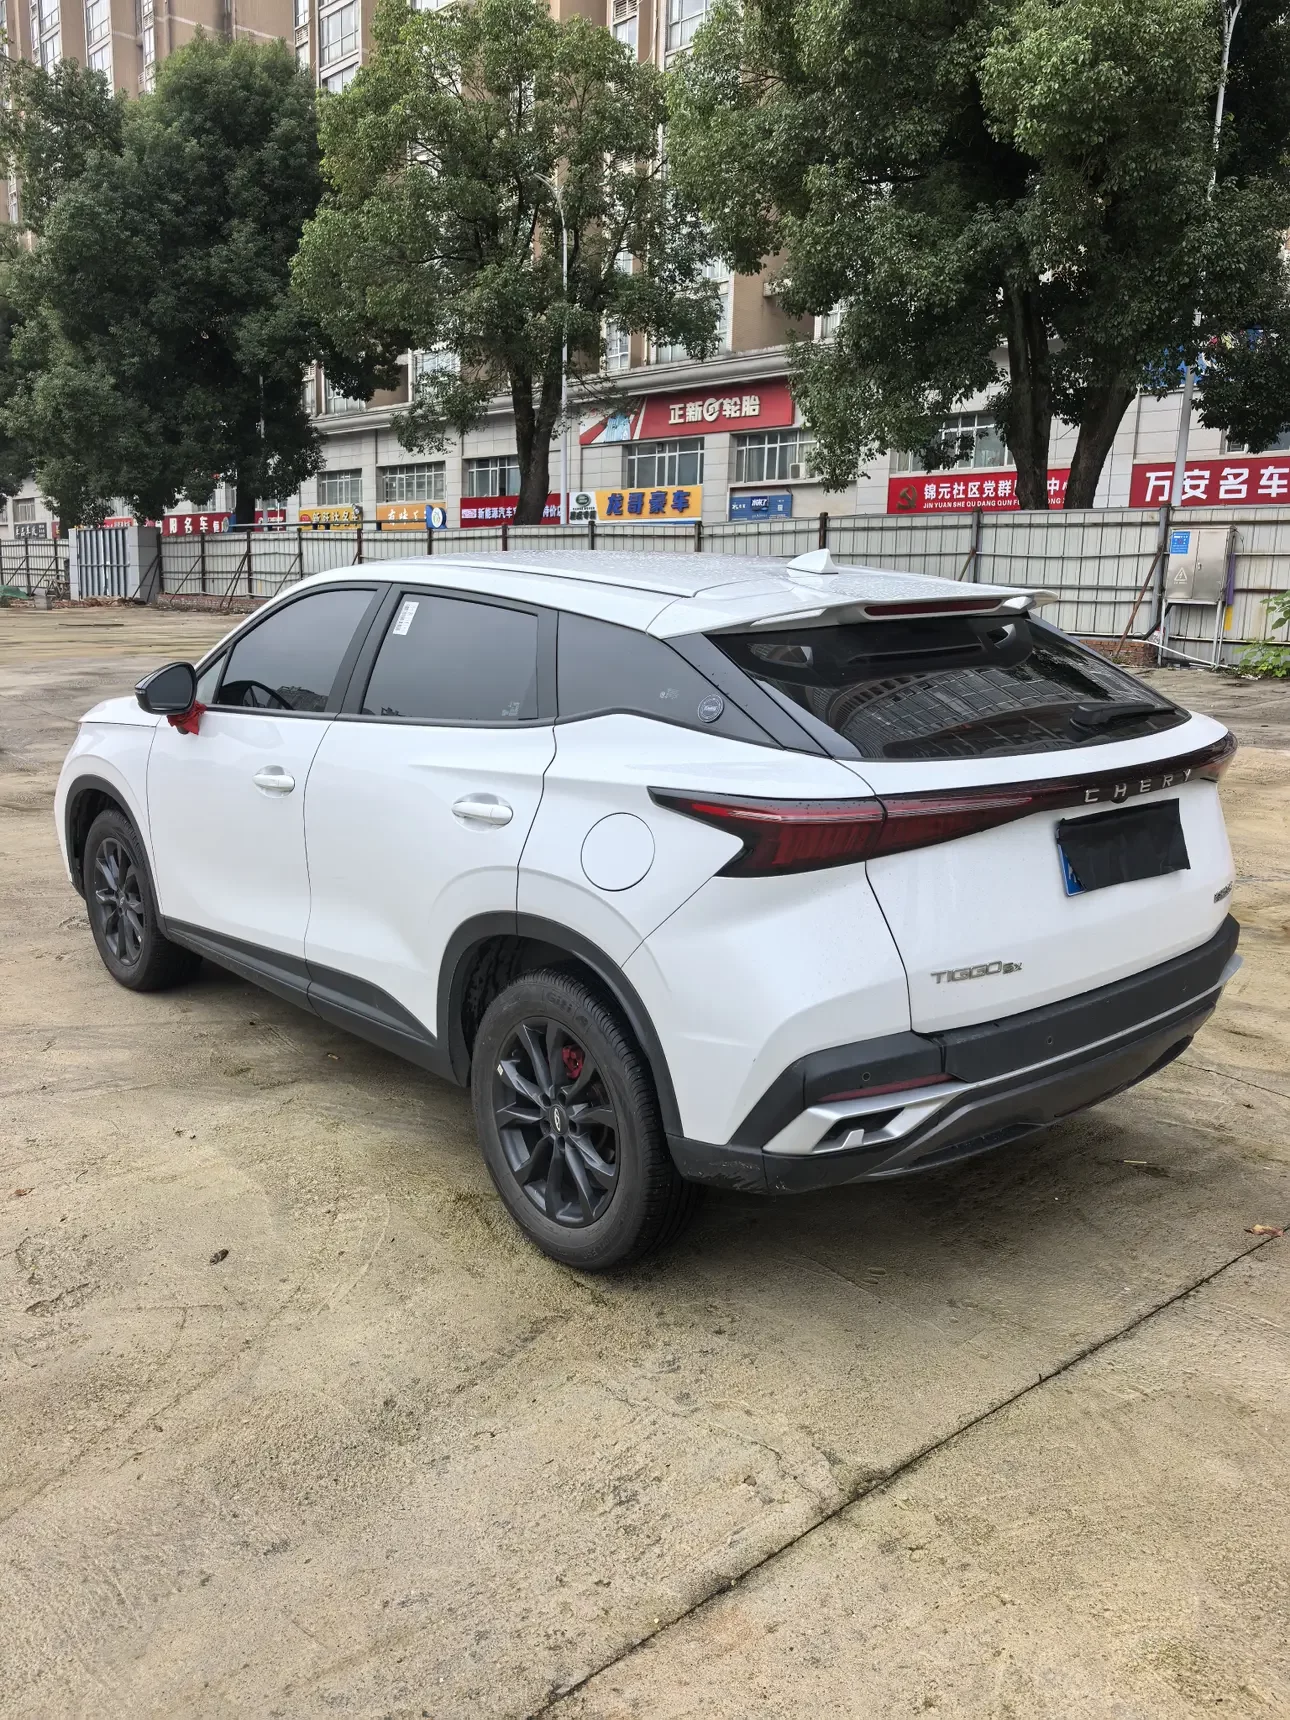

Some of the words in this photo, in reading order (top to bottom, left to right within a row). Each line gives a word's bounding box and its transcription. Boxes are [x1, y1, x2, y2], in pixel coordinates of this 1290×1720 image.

[924, 477, 1068, 500] 锦元社区党群中
[1145, 465, 1290, 502] 万安名车
[606, 489, 691, 516] 龙哥豪车
[1084, 769, 1192, 803] CHERY
